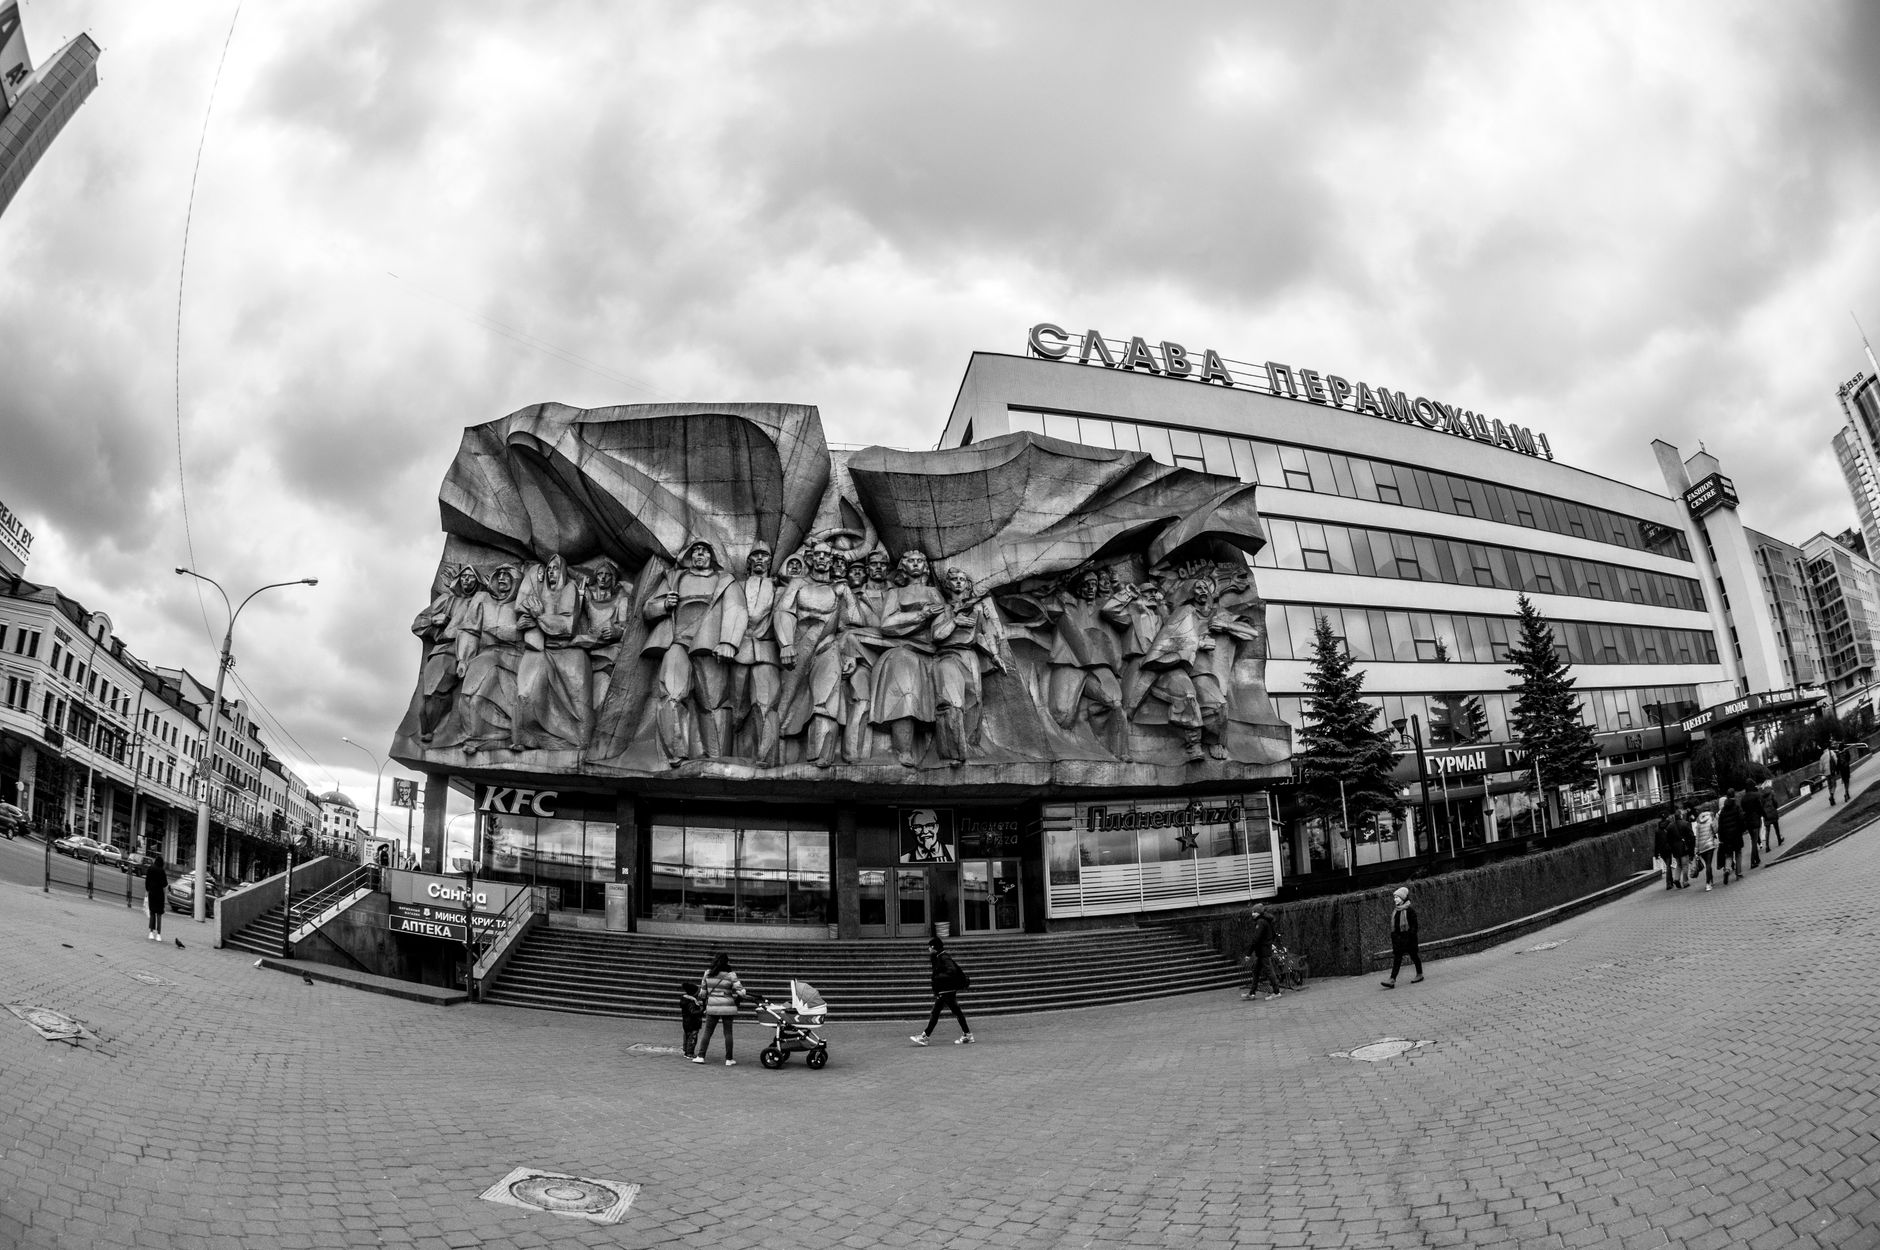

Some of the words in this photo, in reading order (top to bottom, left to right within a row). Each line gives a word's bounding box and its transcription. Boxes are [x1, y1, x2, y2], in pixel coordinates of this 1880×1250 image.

[1029, 322, 1235, 387] СЛАВА
[1264, 360, 1555, 460] ПЕРАМОЖЦАМ!
[1686, 479, 1714, 502] FASHION
[1690, 488, 1717, 509] CENTRE
[1682, 711, 1713, 732] ЦЕНТР
[1724, 700, 1749, 716] МОДЫ
[1425, 751, 1487, 775] ГУРМАН
[478, 785, 559, 817] KFC
[1087, 805, 1187, 832] Планета
[1186, 800, 1242, 826] Pizza
[401, 919, 452, 938] АПТЕКА
[435, 912, 467, 924] МИНСК
